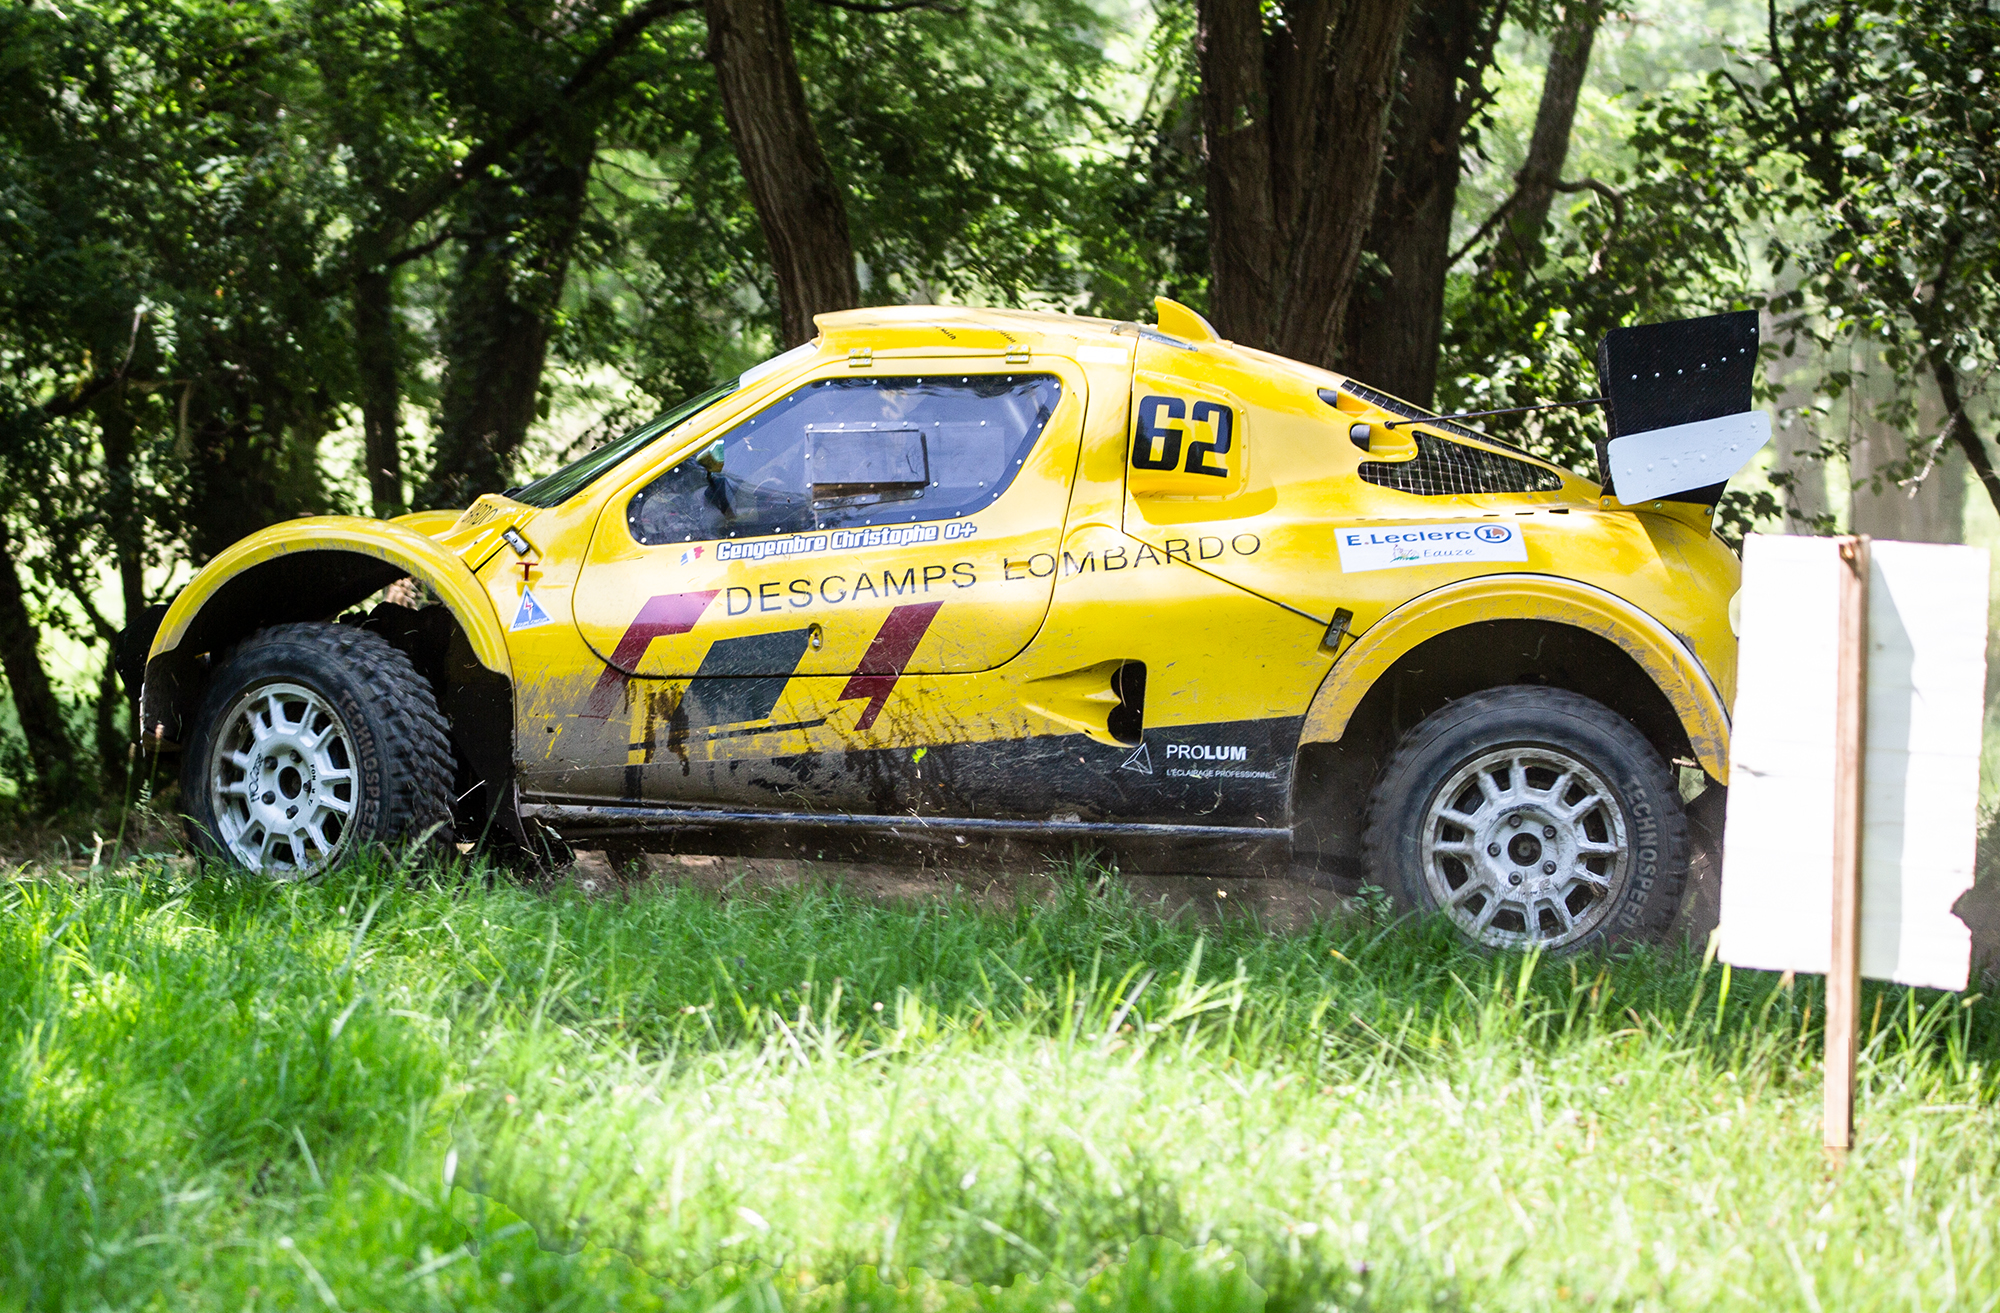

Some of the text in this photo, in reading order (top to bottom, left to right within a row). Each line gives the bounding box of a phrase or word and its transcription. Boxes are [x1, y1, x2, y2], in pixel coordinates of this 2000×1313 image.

[1131, 395, 1234, 478] 62
[716, 535, 826, 561] Gengembre
[830, 524, 939, 549] Christophe
[1346, 530, 1472, 546] E.Leclerc
[1423, 548, 1476, 558] Eauze
[725, 533, 1263, 617] DESCAMPS LOMBARDO
[1165, 744, 1247, 761] PROLUM
[1214, 769, 1278, 780] PROFESSIONNEL
[1618, 773, 1659, 929] TECHNOSPEED
